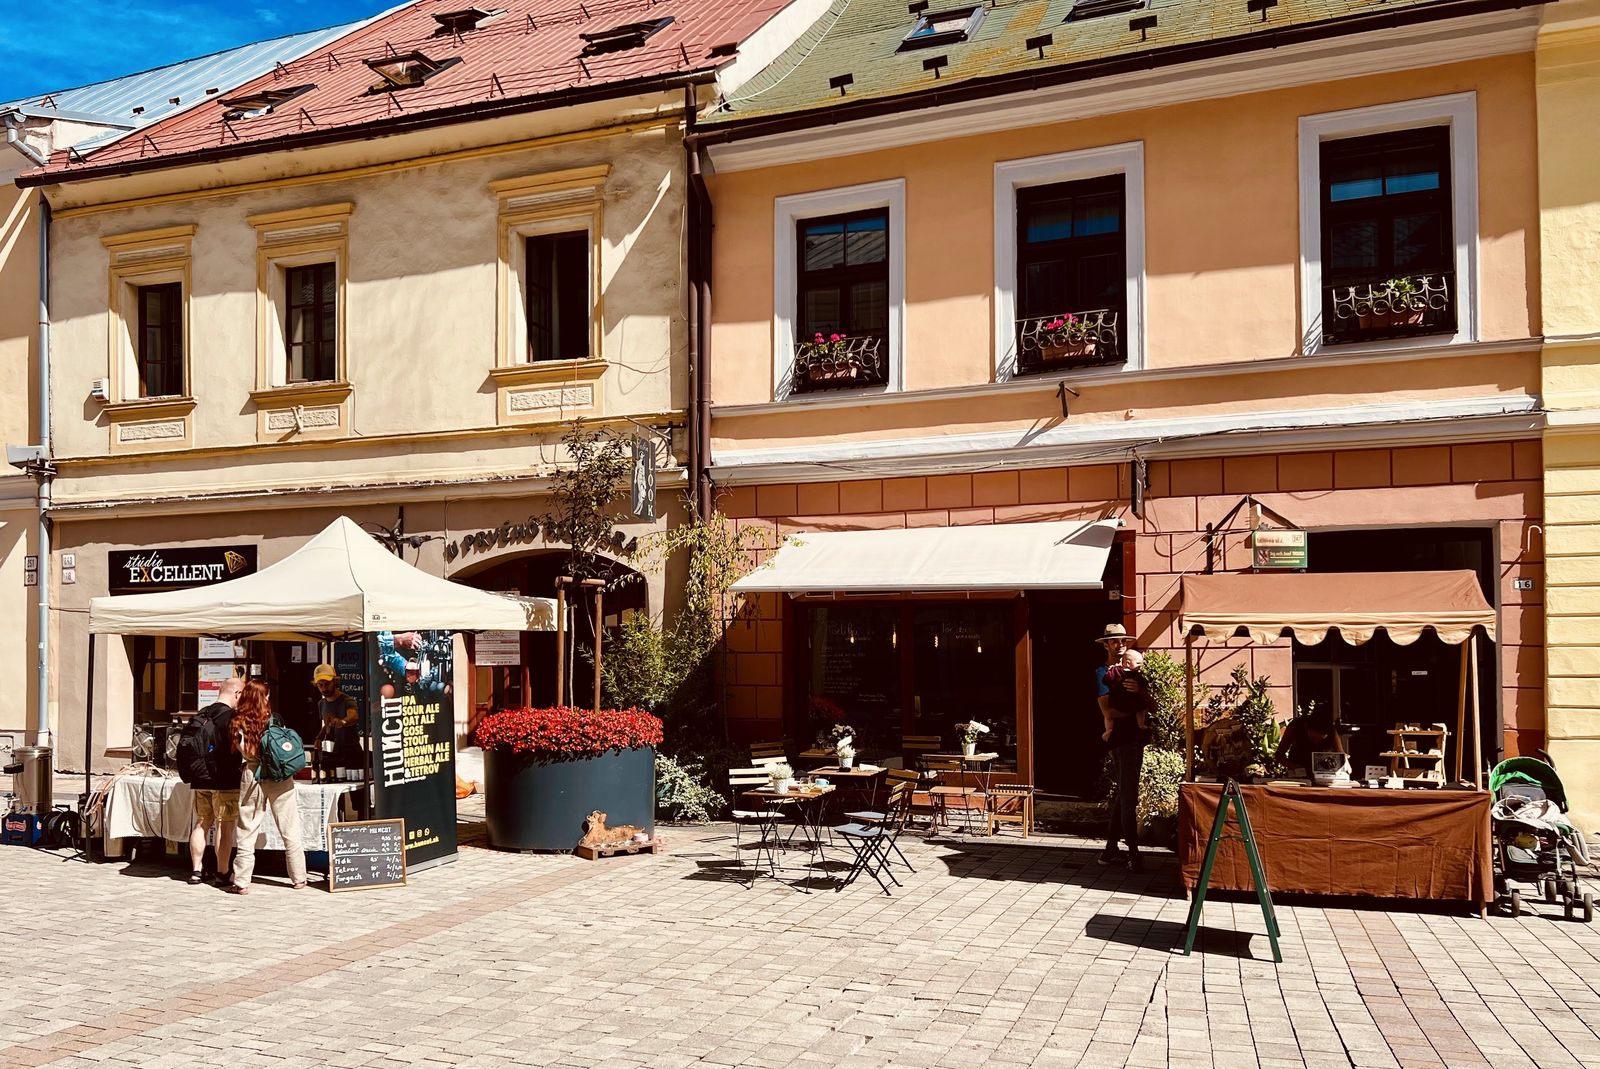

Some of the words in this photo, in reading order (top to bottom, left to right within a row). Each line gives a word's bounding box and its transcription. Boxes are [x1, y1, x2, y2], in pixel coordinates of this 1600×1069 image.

[647, 456, 655, 517] LOOK
[123, 550, 163, 570] štúdio
[129, 563, 225, 583] EXCELLENT
[1518, 580, 1531, 589] 16
[402, 695, 416, 706] IPA
[402, 704, 425, 716] SOUR
[425, 703, 440, 714] ALE
[402, 715, 420, 726] OAT
[420, 714, 435, 724] ALE
[403, 725, 424, 737] GOSE
[403, 734, 429, 747] STOUT
[404, 743, 434, 757] BROWN
[435, 742, 450, 753] ALE
[404, 753, 434, 768] HERBAL
[435, 752, 450, 763] ALE
[334, 866, 359, 874] Tetrov
